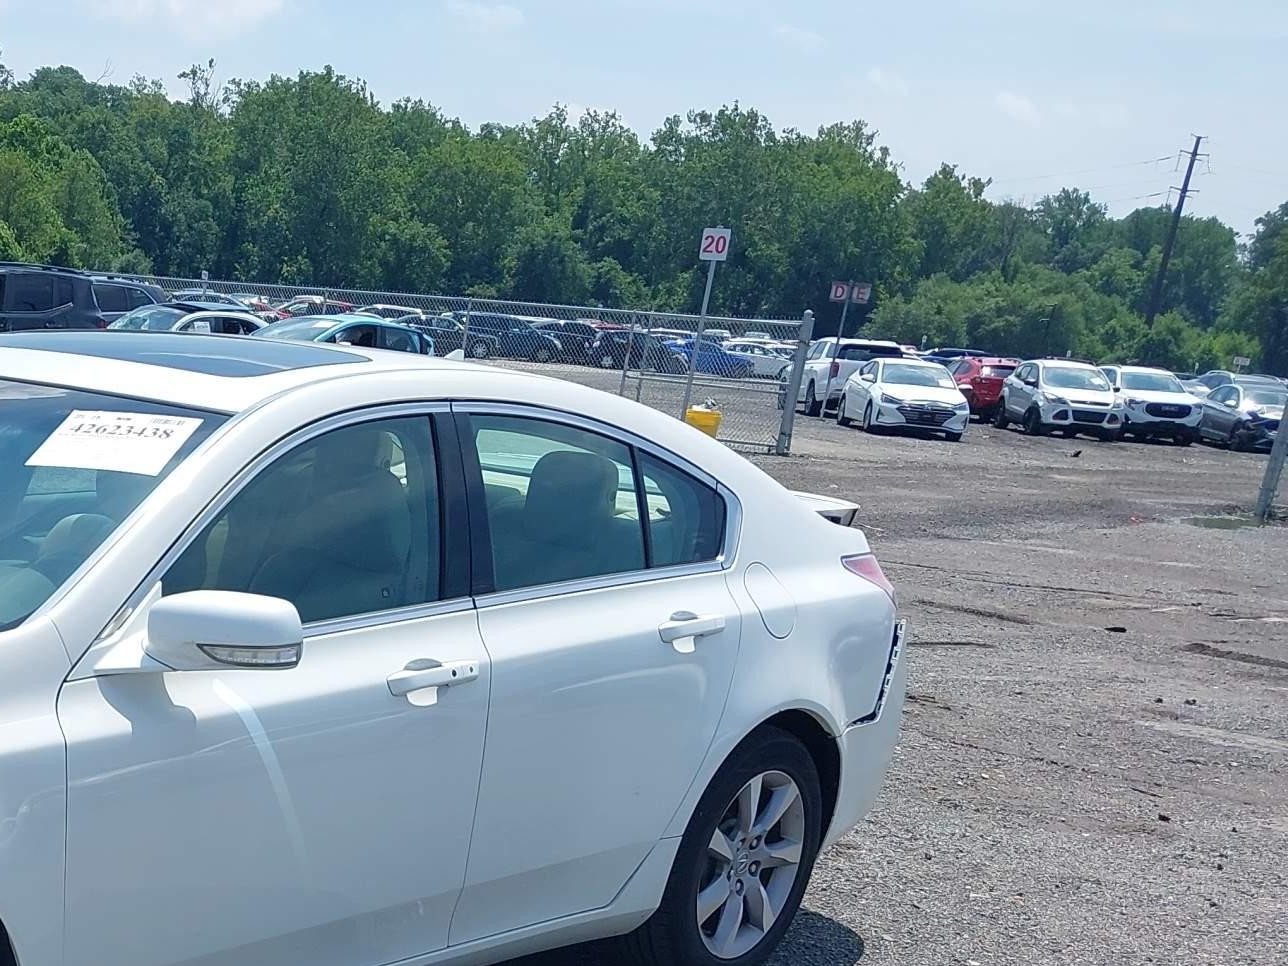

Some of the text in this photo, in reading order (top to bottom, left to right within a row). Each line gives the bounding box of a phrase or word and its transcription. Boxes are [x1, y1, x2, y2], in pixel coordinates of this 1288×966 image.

[702, 235, 727, 254] 20
[834, 285, 845, 299] D
[855, 287, 866, 300] E
[70, 422, 174, 440] 42623438
